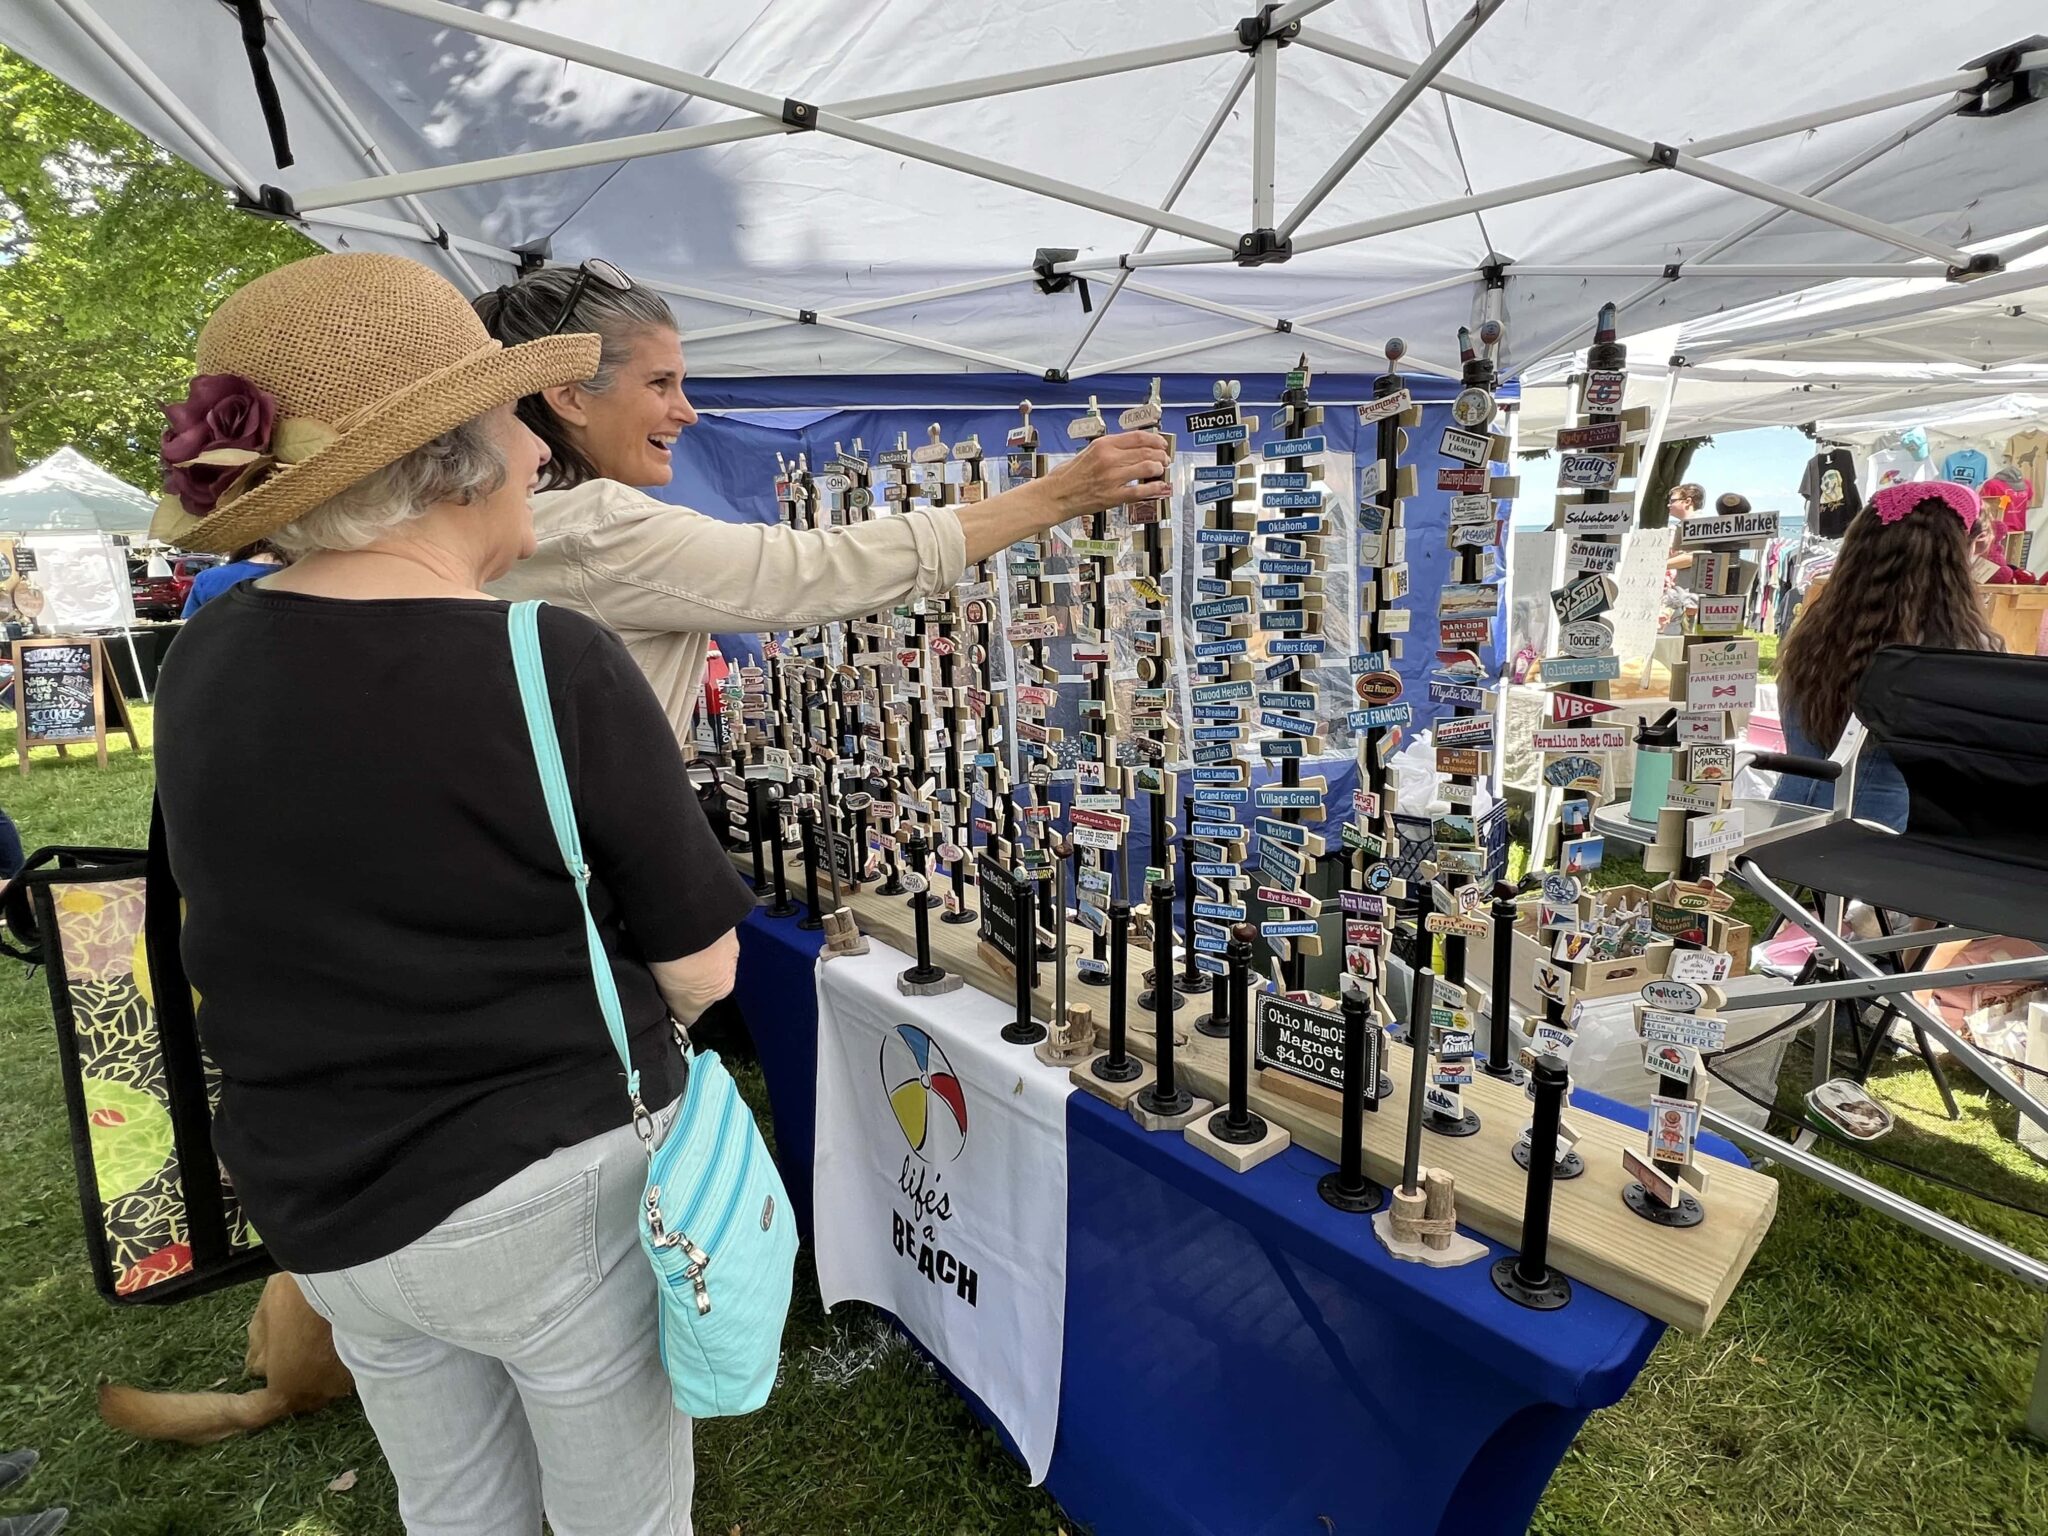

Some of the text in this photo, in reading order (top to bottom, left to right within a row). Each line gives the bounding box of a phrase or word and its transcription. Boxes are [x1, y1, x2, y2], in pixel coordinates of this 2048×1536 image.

[1359, 392, 1406, 416] Brummer's
[1190, 413, 1234, 430] Huron
[1198, 430, 1243, 443] Anderson Acres
[1449, 434, 1482, 448] VERMILION
[1275, 441, 1312, 454] Mudbrook
[1563, 457, 1616, 475] Rudy's
[1290, 476, 1304, 486] Beach
[1266, 494, 1316, 505] Oberlin Beach
[1566, 510, 1630, 524] Salvatore's
[1268, 521, 1308, 532] Oklahoma
[1682, 514, 1778, 538] Farmers Market
[1202, 532, 1244, 543] Breakwater
[1570, 542, 1618, 558] Smokin'
[1263, 562, 1308, 573] Old Homestead
[1584, 558, 1614, 571] Joe's
[1195, 601, 1244, 617] Cold Creek Crossing
[1705, 606, 1739, 614] HAHN
[1266, 616, 1296, 626] Plumbrook
[932, 640, 950, 652] DQ
[1198, 643, 1242, 656] Cranberry Creek
[1276, 644, 1317, 654] Rivers Edge
[1352, 655, 1382, 672] Beach
[1542, 661, 1617, 676] Volunteer Bay
[1690, 674, 1725, 683] FARMER
[1222, 686, 1248, 699] Heights
[1430, 684, 1482, 703] Mystic Belle
[1262, 696, 1311, 708] Sawmill Creek
[1556, 696, 1594, 718] VBC
[1692, 701, 1754, 711] Farm Market
[1196, 708, 1236, 717] The Breakwater
[1264, 714, 1312, 733] The Breakwater
[1350, 712, 1370, 727] CHEZ
[1438, 722, 1490, 736] RESTAURANT
[1532, 734, 1624, 748] Vermilion Boat Club
[767, 754, 784, 764] BAY
[1196, 748, 1229, 760] Franklin Flats
[1694, 748, 1731, 758] KRAMERS
[1694, 757, 1730, 768] MARKET
[1196, 770, 1236, 780] Fries Landing
[1200, 790, 1241, 800] Grand Forest
[1261, 793, 1316, 806] Village Green
[1354, 794, 1372, 806] drug
[1355, 802, 1374, 814] mart
[1196, 827, 1238, 836] Hartley Beach
[1266, 824, 1292, 840] Wexford
[1342, 826, 1382, 854] Exchange Park
[1694, 831, 1742, 848] PRAIRIE VIEW
[1262, 842, 1296, 870] Wexford West
[1196, 866, 1233, 876] Hidden Valley
[1267, 892, 1302, 905] Rye Beach
[1340, 894, 1382, 913] Farm Market
[1198, 906, 1241, 919] Huron Heights
[1266, 924, 1314, 934] Old Homestead
[1435, 988, 1452, 1000] PARK
[1268, 1008, 1300, 1030] Ohio
[1643, 1012, 1675, 1022] WELCOME
[1643, 1022, 1666, 1030] FRESH
[1539, 1028, 1574, 1048] VERMILION
[1640, 1030, 1714, 1048] GROWN HERE
[1442, 1041, 1474, 1054] MARINA
[1276, 1044, 1324, 1072] $4.00
[1648, 1056, 1689, 1078] BURNHAM
[898, 1154, 952, 1222] life's
[922, 1224, 936, 1242] a
[893, 1208, 978, 1308] BEACH
